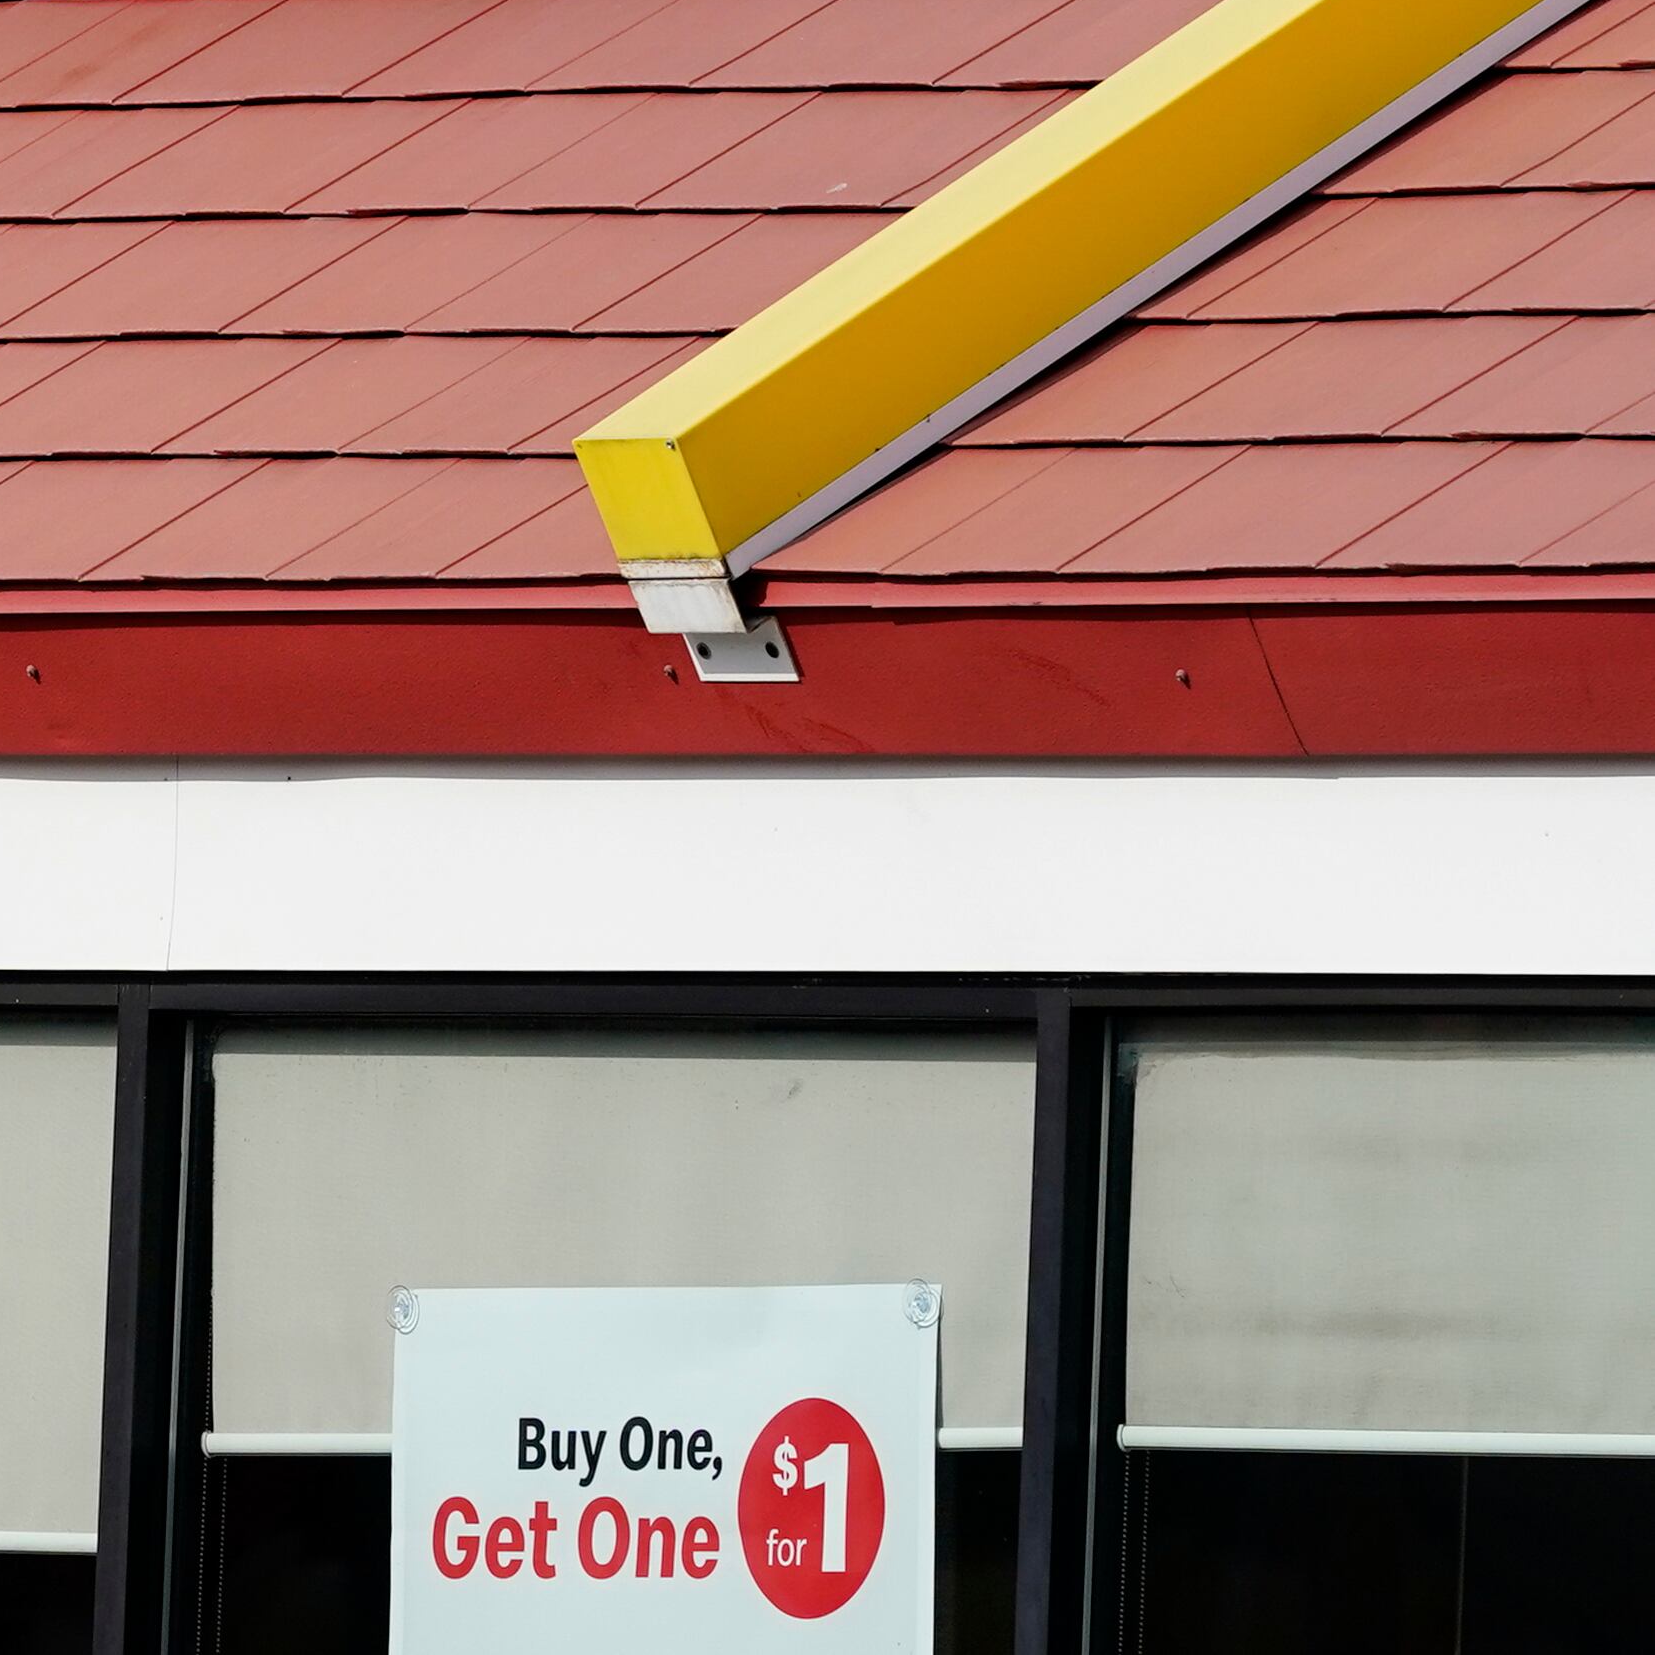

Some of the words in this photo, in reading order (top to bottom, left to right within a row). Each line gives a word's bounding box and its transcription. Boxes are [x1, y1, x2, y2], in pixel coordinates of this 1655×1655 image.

[517, 1416, 606, 1488] Buy
[619, 1416, 724, 1482] One,
[432, 1496, 557, 1580] Get
[578, 1496, 720, 1580] One
[766, 1528, 808, 1568] for
